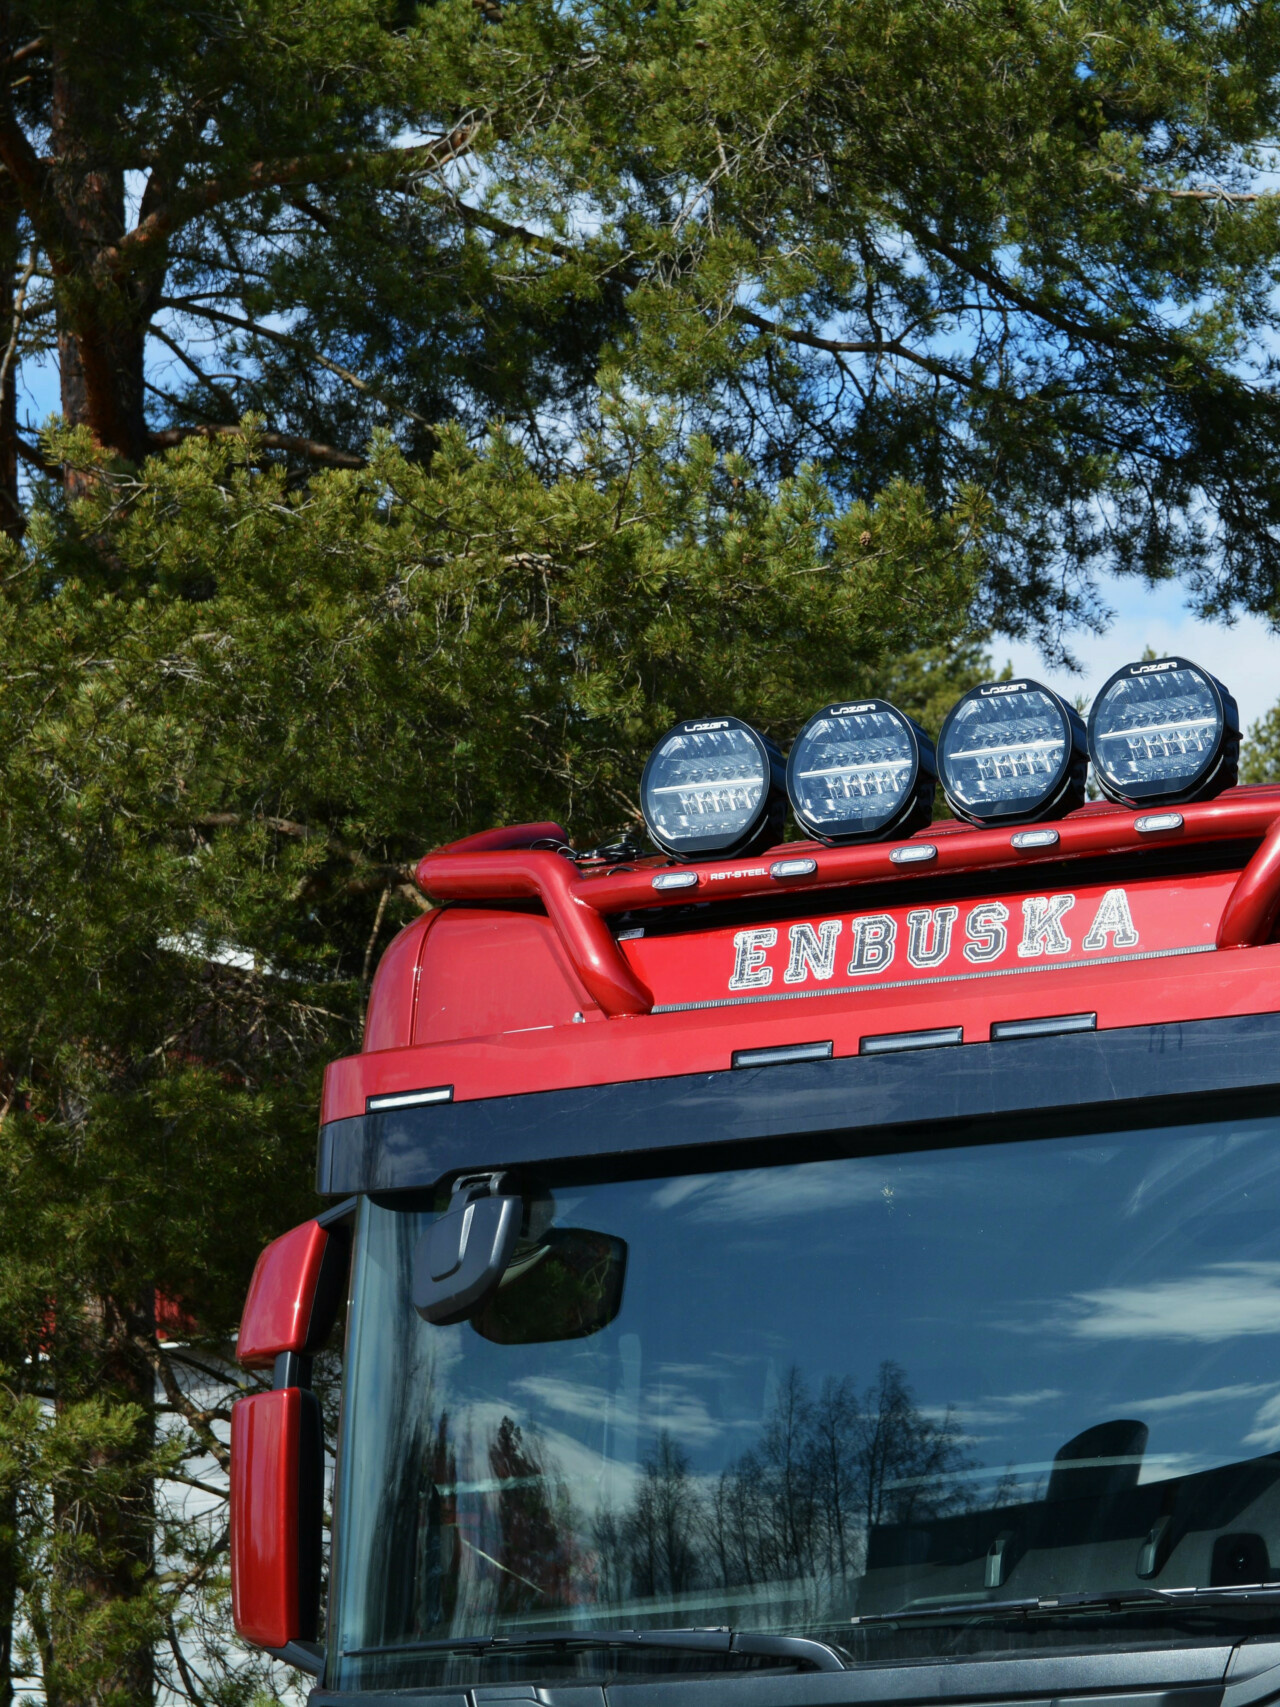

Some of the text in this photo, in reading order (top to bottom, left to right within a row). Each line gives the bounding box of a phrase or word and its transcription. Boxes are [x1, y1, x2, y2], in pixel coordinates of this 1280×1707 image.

[1130, 661, 1178, 675] LAZER
[981, 683, 1027, 696] LAZER
[830, 703, 876, 715] LAZER
[684, 720, 729, 732] LAZER
[710, 868, 768, 881] RST-STEEL
[728, 888, 1139, 990] ENBUSKA
